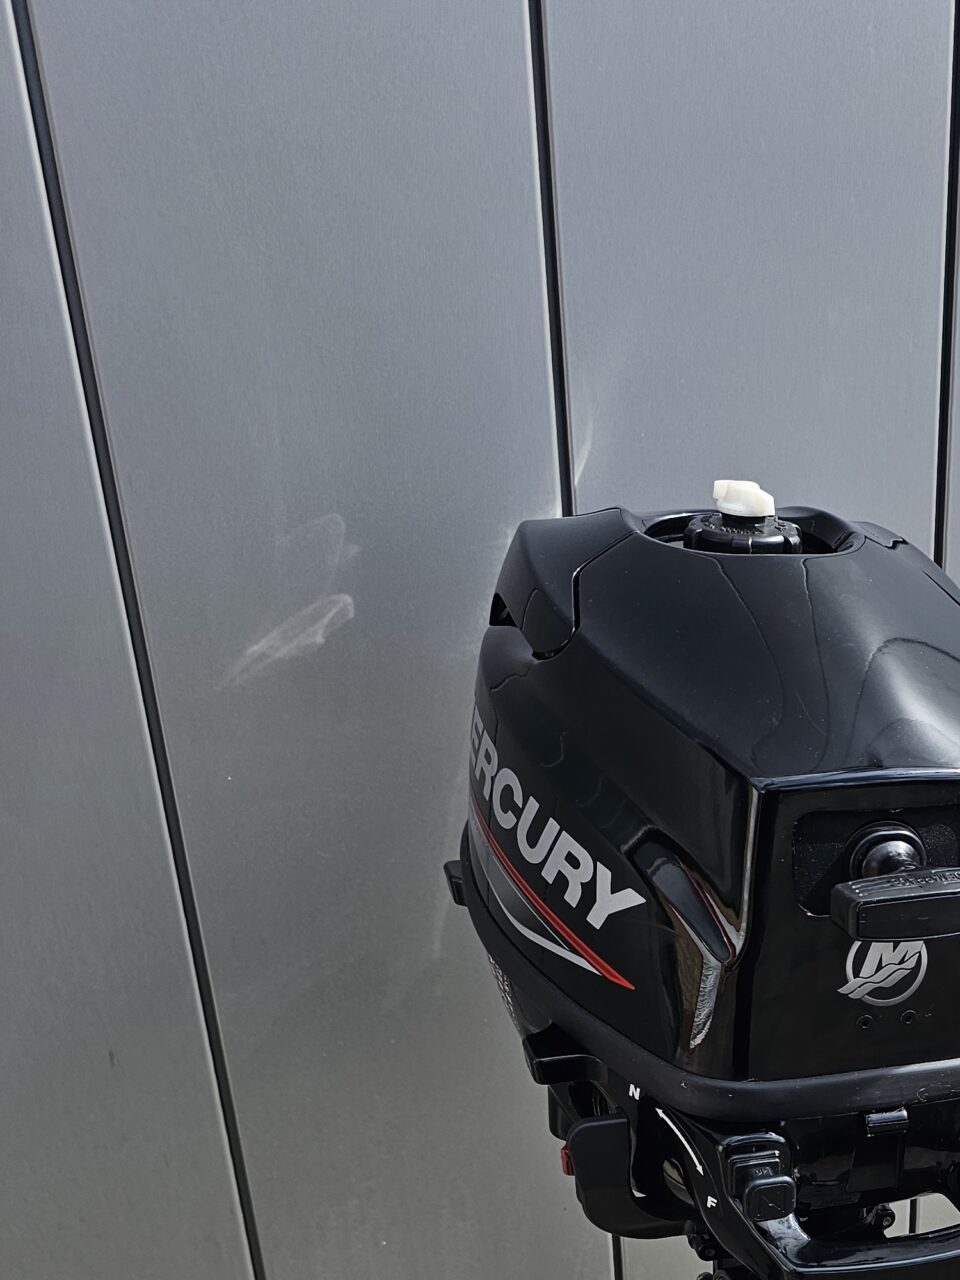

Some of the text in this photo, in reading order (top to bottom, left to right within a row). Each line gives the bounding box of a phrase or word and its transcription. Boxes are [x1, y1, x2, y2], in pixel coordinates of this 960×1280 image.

[470, 705, 646, 929] ERCURY
[628, 1084, 641, 1100] N
[706, 1195, 718, 1208] F
